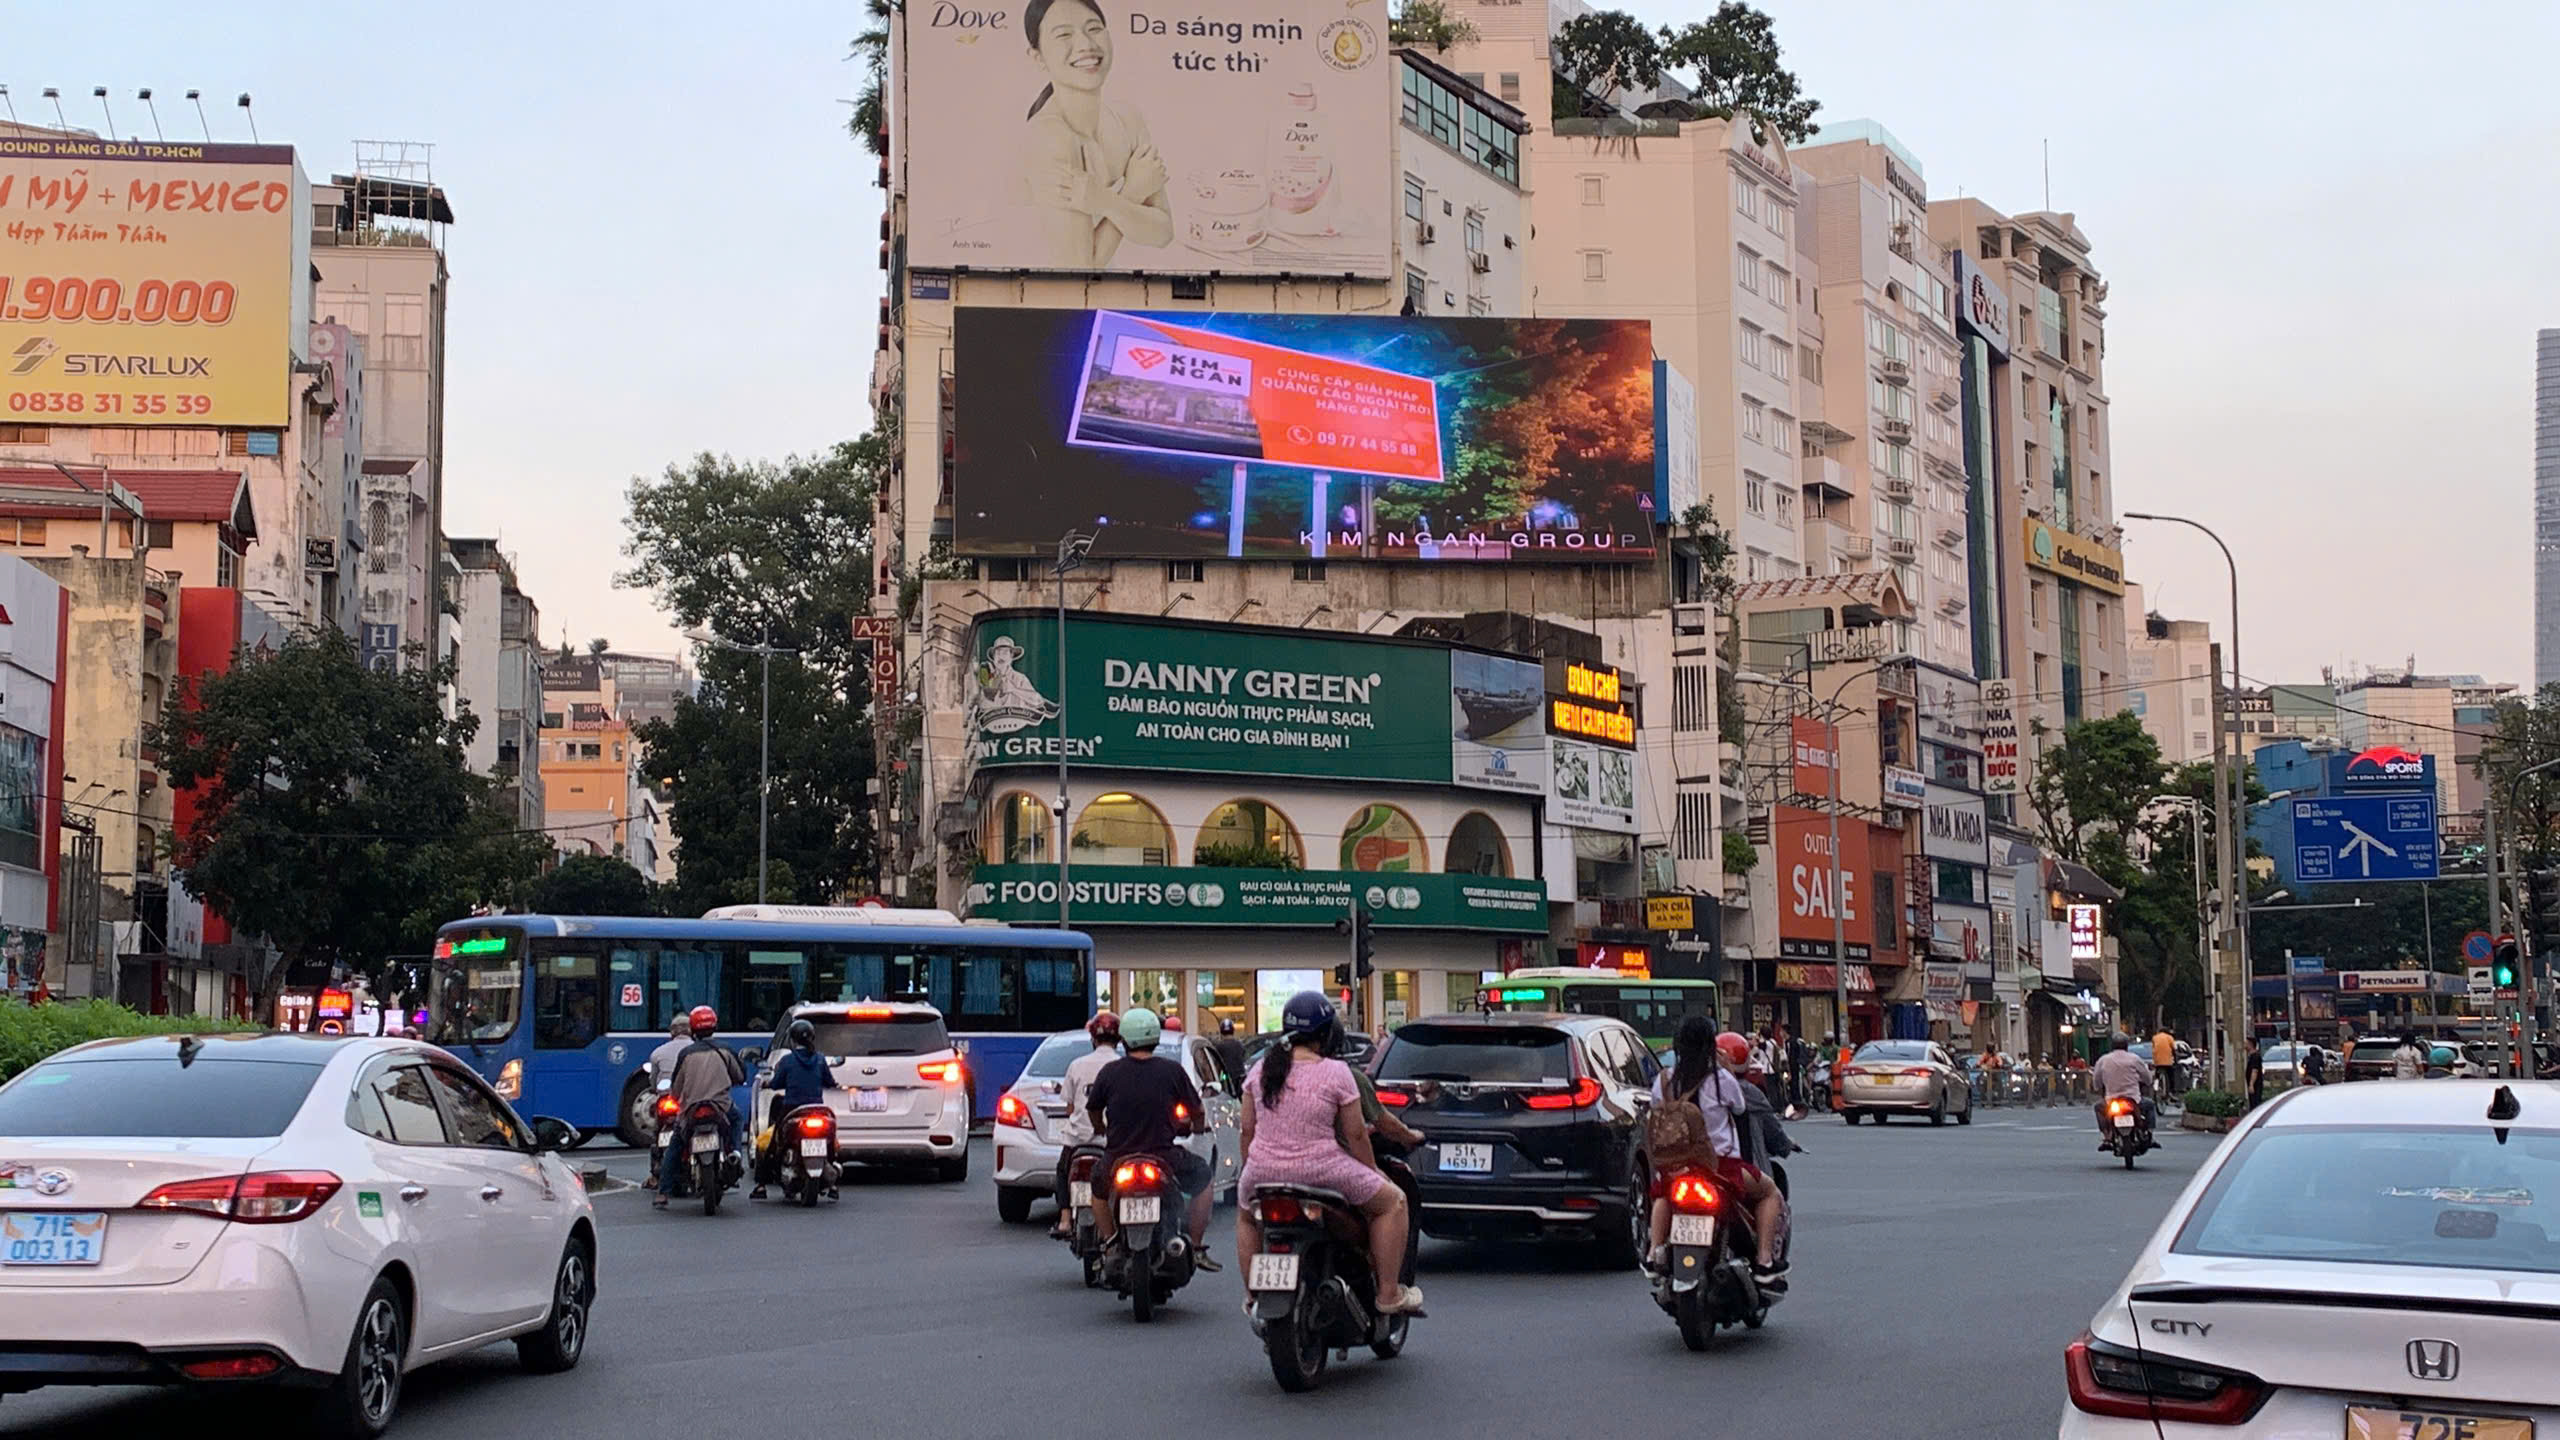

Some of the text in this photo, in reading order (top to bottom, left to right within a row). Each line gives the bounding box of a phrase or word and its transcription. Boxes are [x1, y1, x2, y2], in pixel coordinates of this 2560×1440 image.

[930, 1, 1006, 29] Dove
[1130, 13, 1302, 45] Da sáng mịn
[1172, 50, 1216, 71] tức
[1285, 129, 1319, 143] Dove
[55, 139, 100, 155] HÀNG
[143, 145, 203, 158] TP.HCM
[27, 168, 89, 214] MỸ
[128, 178, 288, 213] MEXICO
[116, 223, 167, 243] Thân
[64, 354, 209, 376] STARLUX
[1171, 354, 1219, 371] KIM
[1170, 366, 1242, 386] NGAN
[1278, 367, 1320, 384] CUNG
[1324, 371, 1351, 389] CẤP
[1385, 384, 1419, 402] PHÁP
[1262, 374, 1319, 395] QUẢNG
[1322, 382, 1350, 401] CÁO
[1355, 389, 1399, 411] NGOÀI
[8, 392, 212, 415] 0838 31 35 39
[1316, 396, 1356, 416] HÀNG
[1318, 431, 1336, 446] 09
[1340, 432, 1356, 448] 77
[1360, 434, 1377, 450] 44
[1300, 531, 1637, 548] KIM NGAN GROUP
[1104, 659, 1372, 704] DANNY GREEN
[1568, 661, 1594, 697] BÚN
[1108, 693, 1143, 712] ĐẢM
[1147, 696, 1181, 715] BẢO
[1184, 699, 1238, 719] NGUỒN
[1241, 705, 1283, 723] THỰC
[1332, 711, 1374, 730] SẠCH,
[1986, 709, 2012, 720] NHA
[1136, 722, 1158, 738] AN
[1162, 722, 1204, 741] TOÀN
[1208, 726, 1240, 743] CHO
[1244, 729, 1270, 745] GIA
[1273, 728, 1308, 747] ĐÌNH
[1311, 733, 1341, 752] BẠN
[1984, 726, 2017, 738] KHOA
[1005, 737, 1095, 756] GREEN
[1984, 741, 2017, 758] TÂM
[2385, 763, 2424, 773] SPORTS
[1929, 805, 1982, 843] NHA KHOA
[1001, 881, 1162, 905] FOODSTUFFS
[1240, 881, 1259, 892] RAU
[1793, 864, 1855, 920] SALE
[1272, 896, 1285, 905] AN
[1649, 900, 1690, 912] BÚN CHẢ
[2361, 977, 2419, 985] PETROLIMEX
[624, 986, 641, 1003] 56
[1752, 1004, 1773, 1021] BIG
[1456, 1145, 1476, 1157] 51K
[1447, 1158, 1486, 1169] 169.17
[34, 1216, 73, 1236] 71E
[10, 1240, 89, 1260] 003.13
[1257, 1272, 1289, 1287] 8434
[2150, 1318, 2213, 1337] CITY
